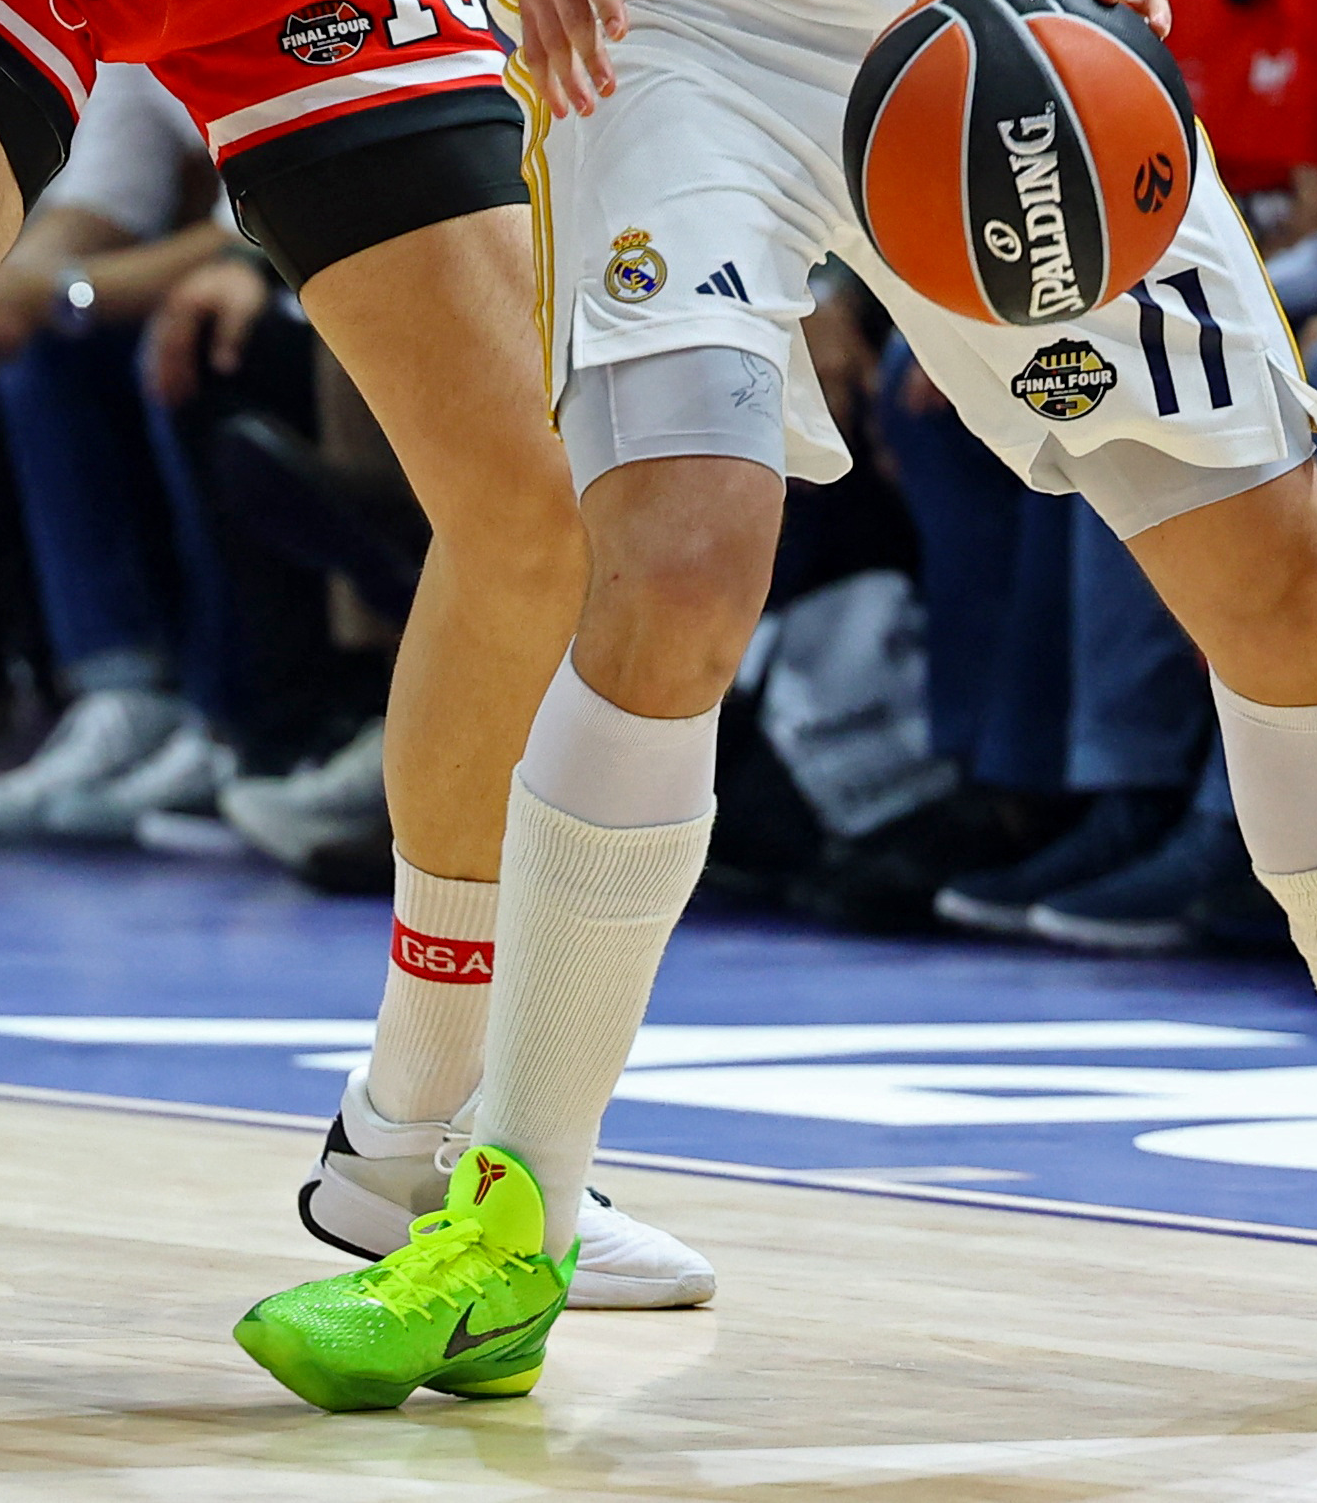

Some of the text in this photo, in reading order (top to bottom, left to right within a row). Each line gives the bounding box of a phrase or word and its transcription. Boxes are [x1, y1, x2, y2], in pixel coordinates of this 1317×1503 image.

[282, 18, 371, 50] FINAL FOUR
[997, 101, 1085, 319] SPALDING
[1125, 266, 1233, 417] 11
[1016, 370, 1113, 394] FINAL FOUR
[400, 934, 493, 975] GSA
